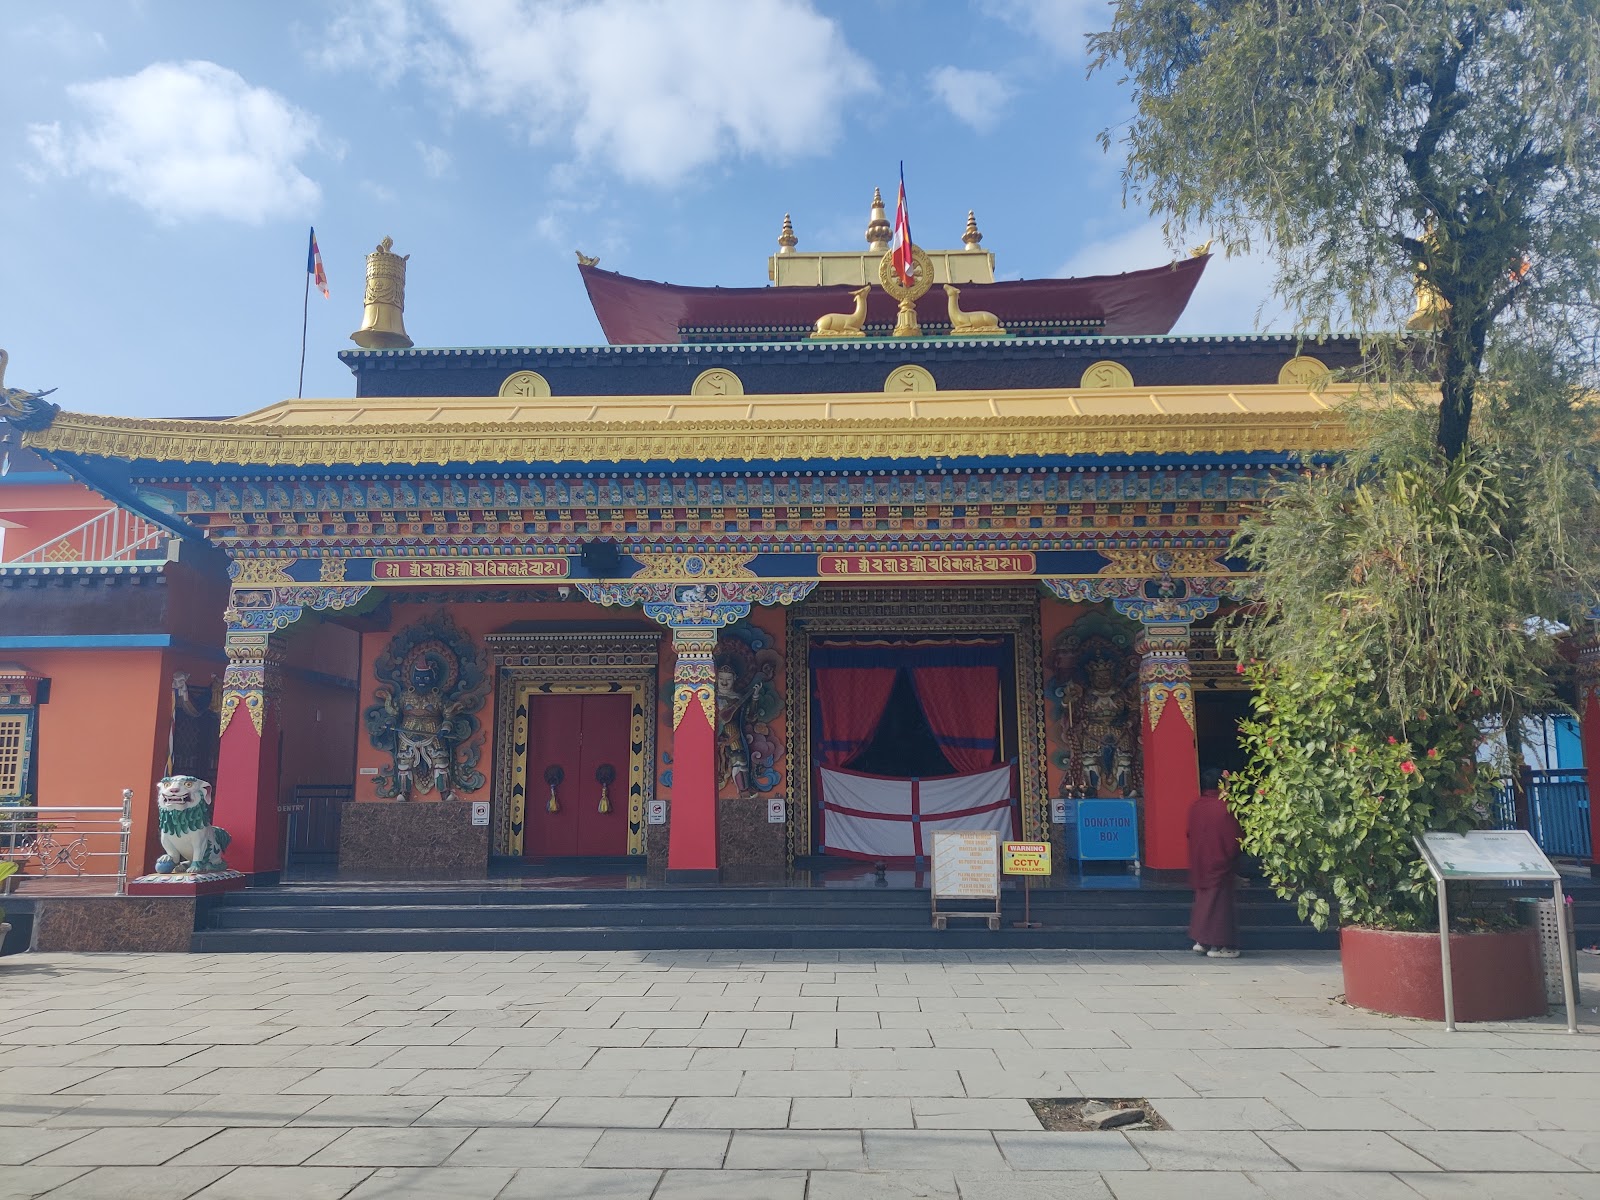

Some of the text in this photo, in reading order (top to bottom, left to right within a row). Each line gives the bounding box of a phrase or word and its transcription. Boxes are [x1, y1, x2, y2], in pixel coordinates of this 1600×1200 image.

[282, 804, 305, 812] ENTRY
[1084, 817, 1130, 827] DONATION
[1100, 831, 1119, 841] BOX
[1013, 859, 1040, 867] CCTV
